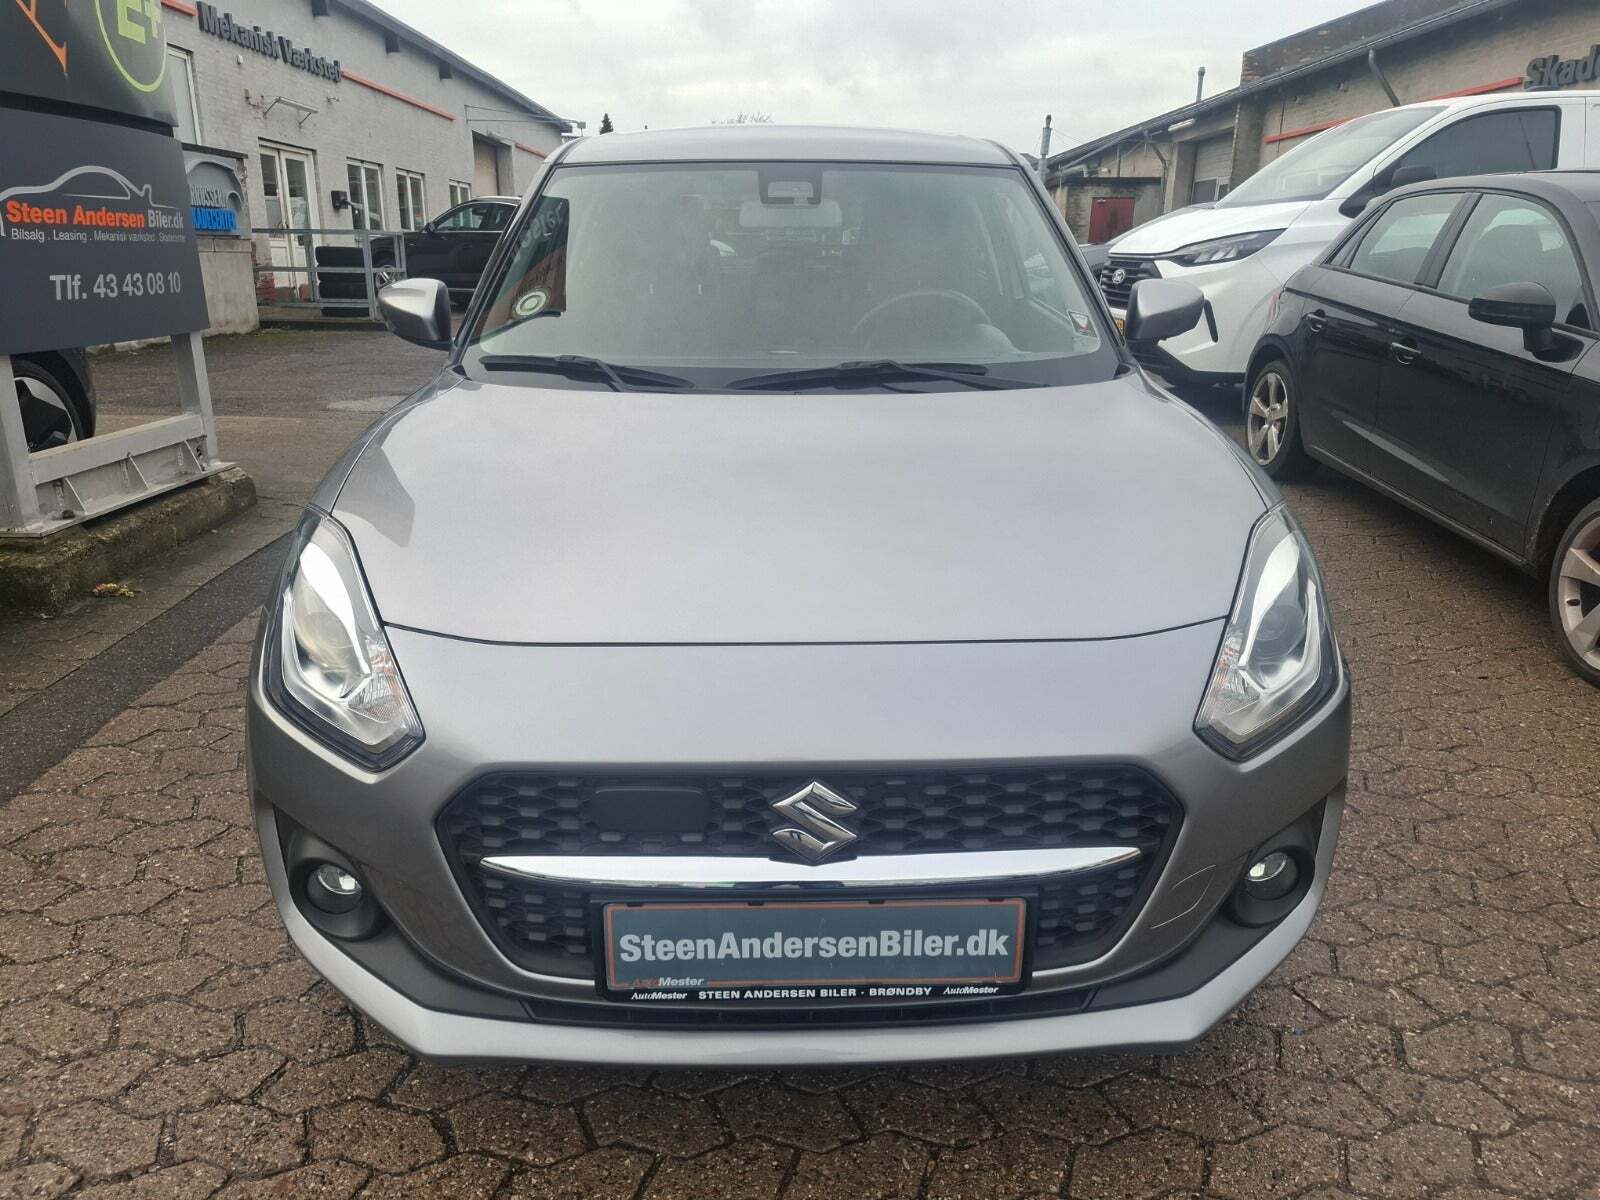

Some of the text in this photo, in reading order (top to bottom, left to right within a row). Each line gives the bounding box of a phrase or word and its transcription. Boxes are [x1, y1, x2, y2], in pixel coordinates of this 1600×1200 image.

[196, 1, 341, 83] Mekanisk Værksted
[6, 200, 184, 229] Steen Andersen Biler.dk
[11, 228, 45, 243] Bilsalg
[53, 230, 87, 243] Leasing
[50, 271, 181, 301] Tlf. 43 43 08 10
[619, 929, 1009, 962] SteenAndersenBiler.dk
[631, 985, 999, 1001] AutoMester STEEN ANDERSEN BILER BRØNDBY AutoMester
